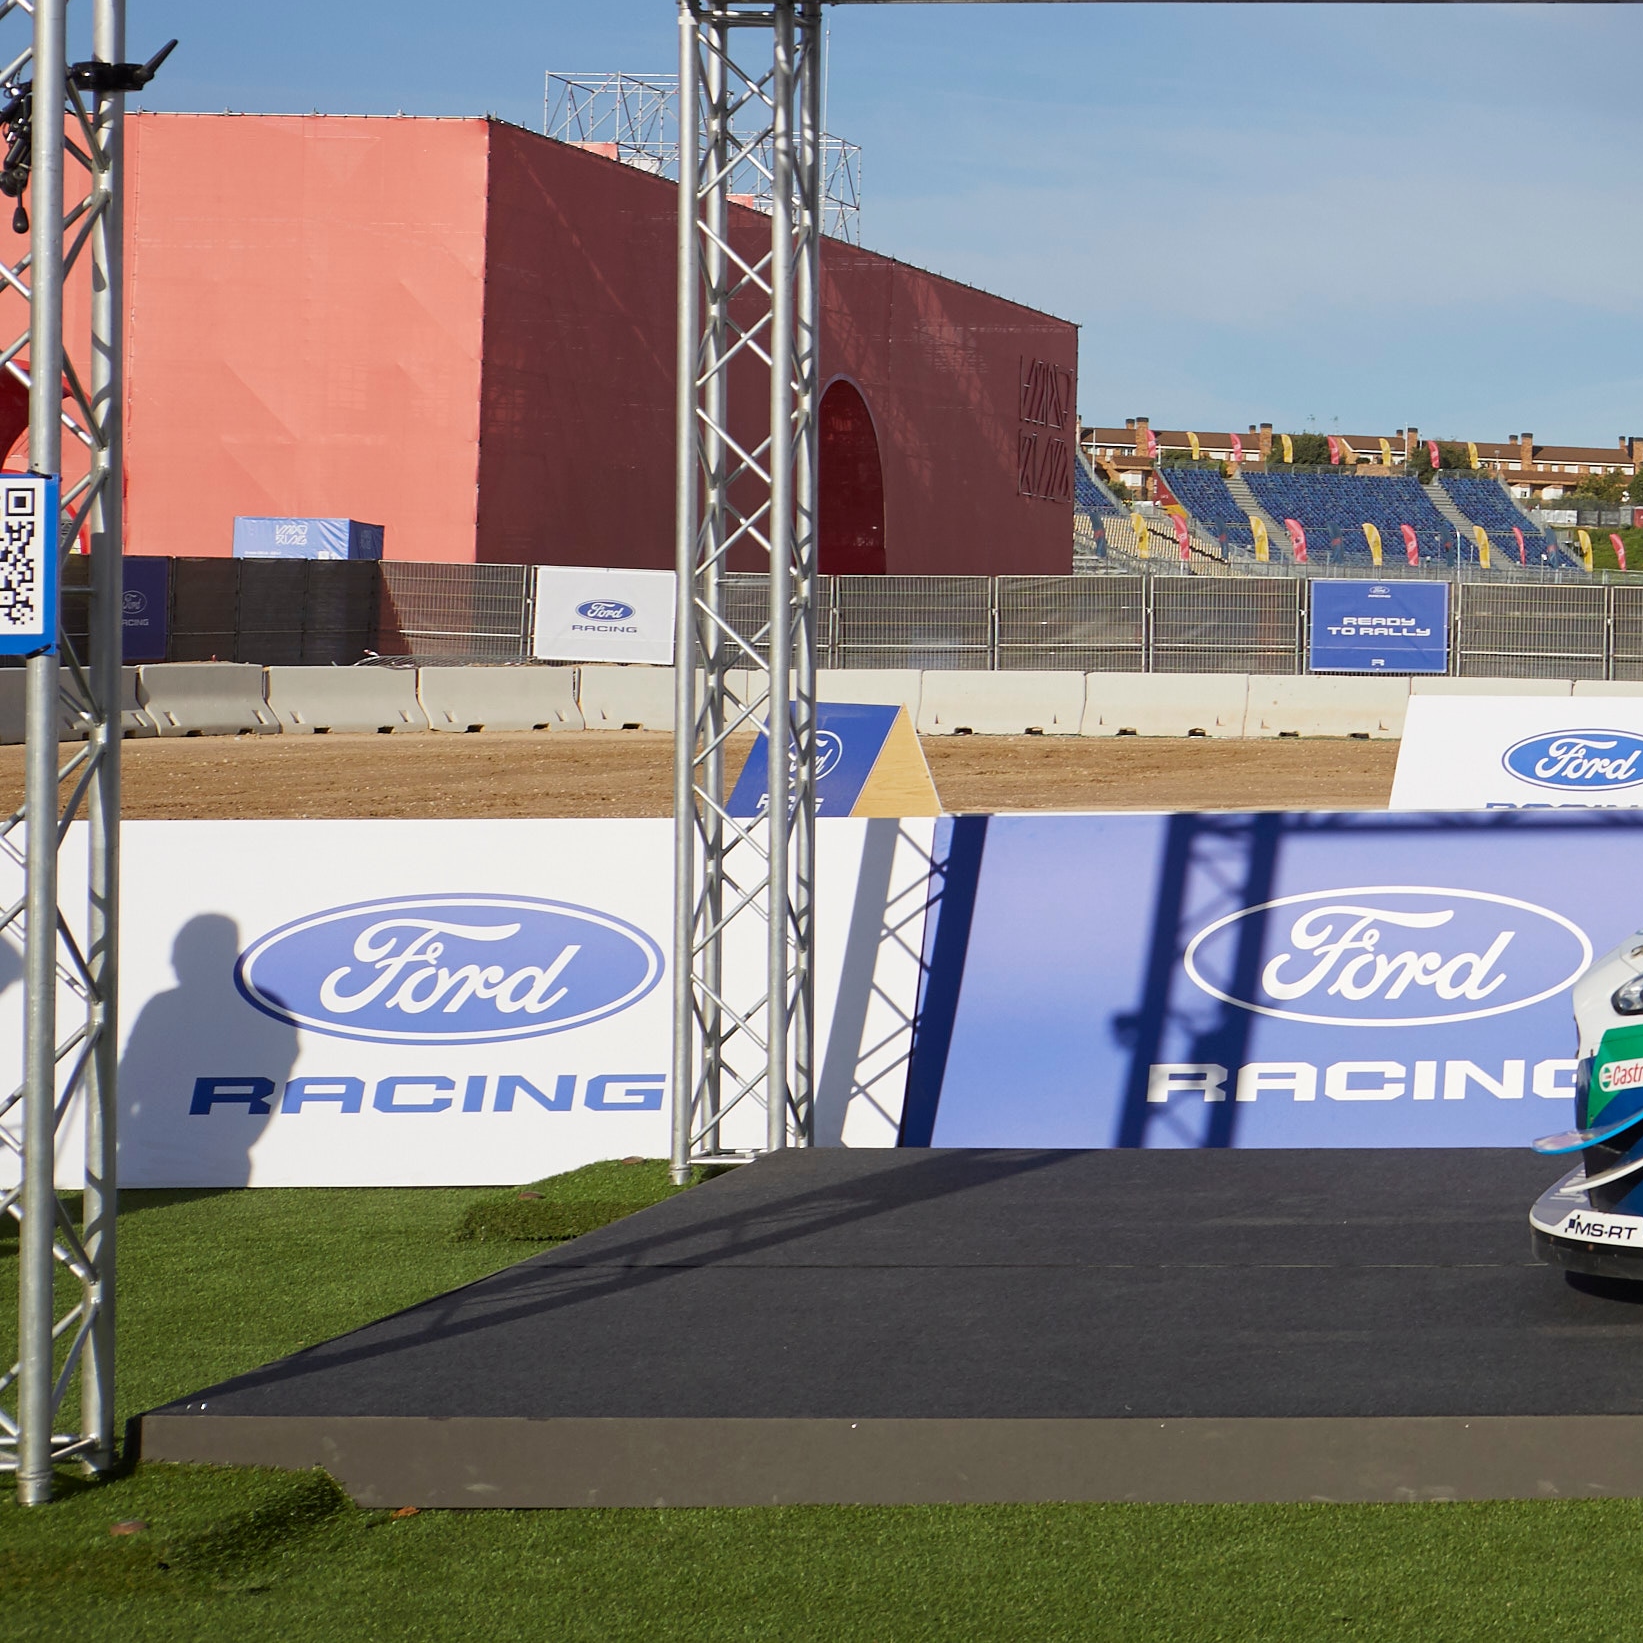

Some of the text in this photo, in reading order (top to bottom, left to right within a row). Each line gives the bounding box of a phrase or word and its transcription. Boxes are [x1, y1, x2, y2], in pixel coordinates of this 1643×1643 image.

[587, 602, 625, 618] Ford
[571, 624, 638, 633] RACING
[1342, 617, 1416, 627] READY
[1327, 627, 1431, 637] TO RALLY
[1535, 738, 1642, 779] Ford
[1262, 905, 1516, 1000] Ford
[319, 918, 582, 1014] Ford
[189, 1073, 667, 1115] RACING
[1574, 1222, 1638, 1240] MS-RT
